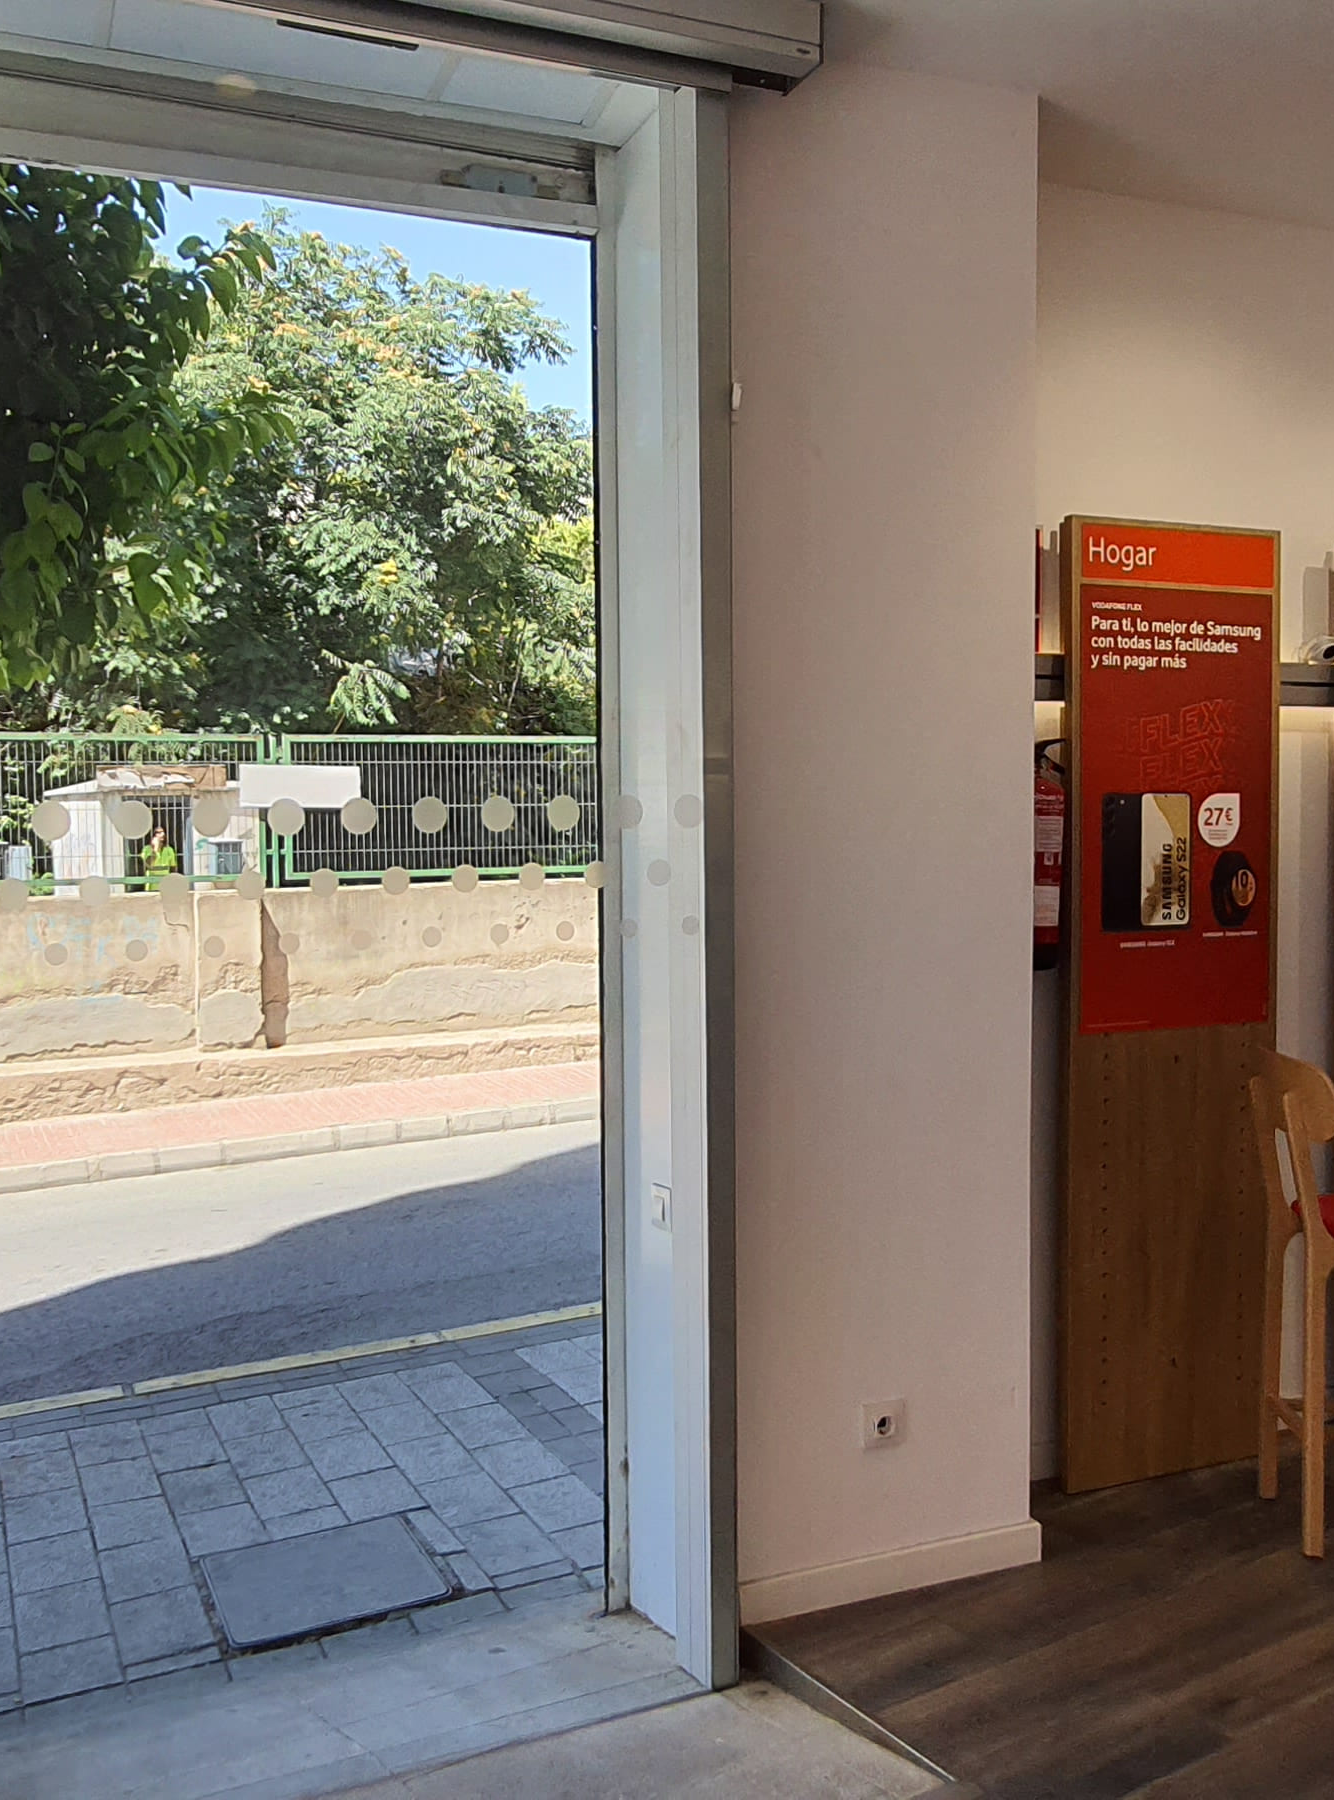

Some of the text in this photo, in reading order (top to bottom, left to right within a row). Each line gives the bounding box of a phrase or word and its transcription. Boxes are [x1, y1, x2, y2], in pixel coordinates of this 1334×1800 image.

[1088, 536, 1157, 571] Hogar
[1091, 615, 1261, 641] Para ti, lo mejor de Samsung
[1091, 635, 1238, 654] con todas las facilidades
[1091, 652, 1187, 671] y sin pagar más
[1139, 698, 1223, 752] FLEX
[1162, 843, 1173, 921] SAMSUNG
[1176, 836, 1190, 921] Galaxy S22
